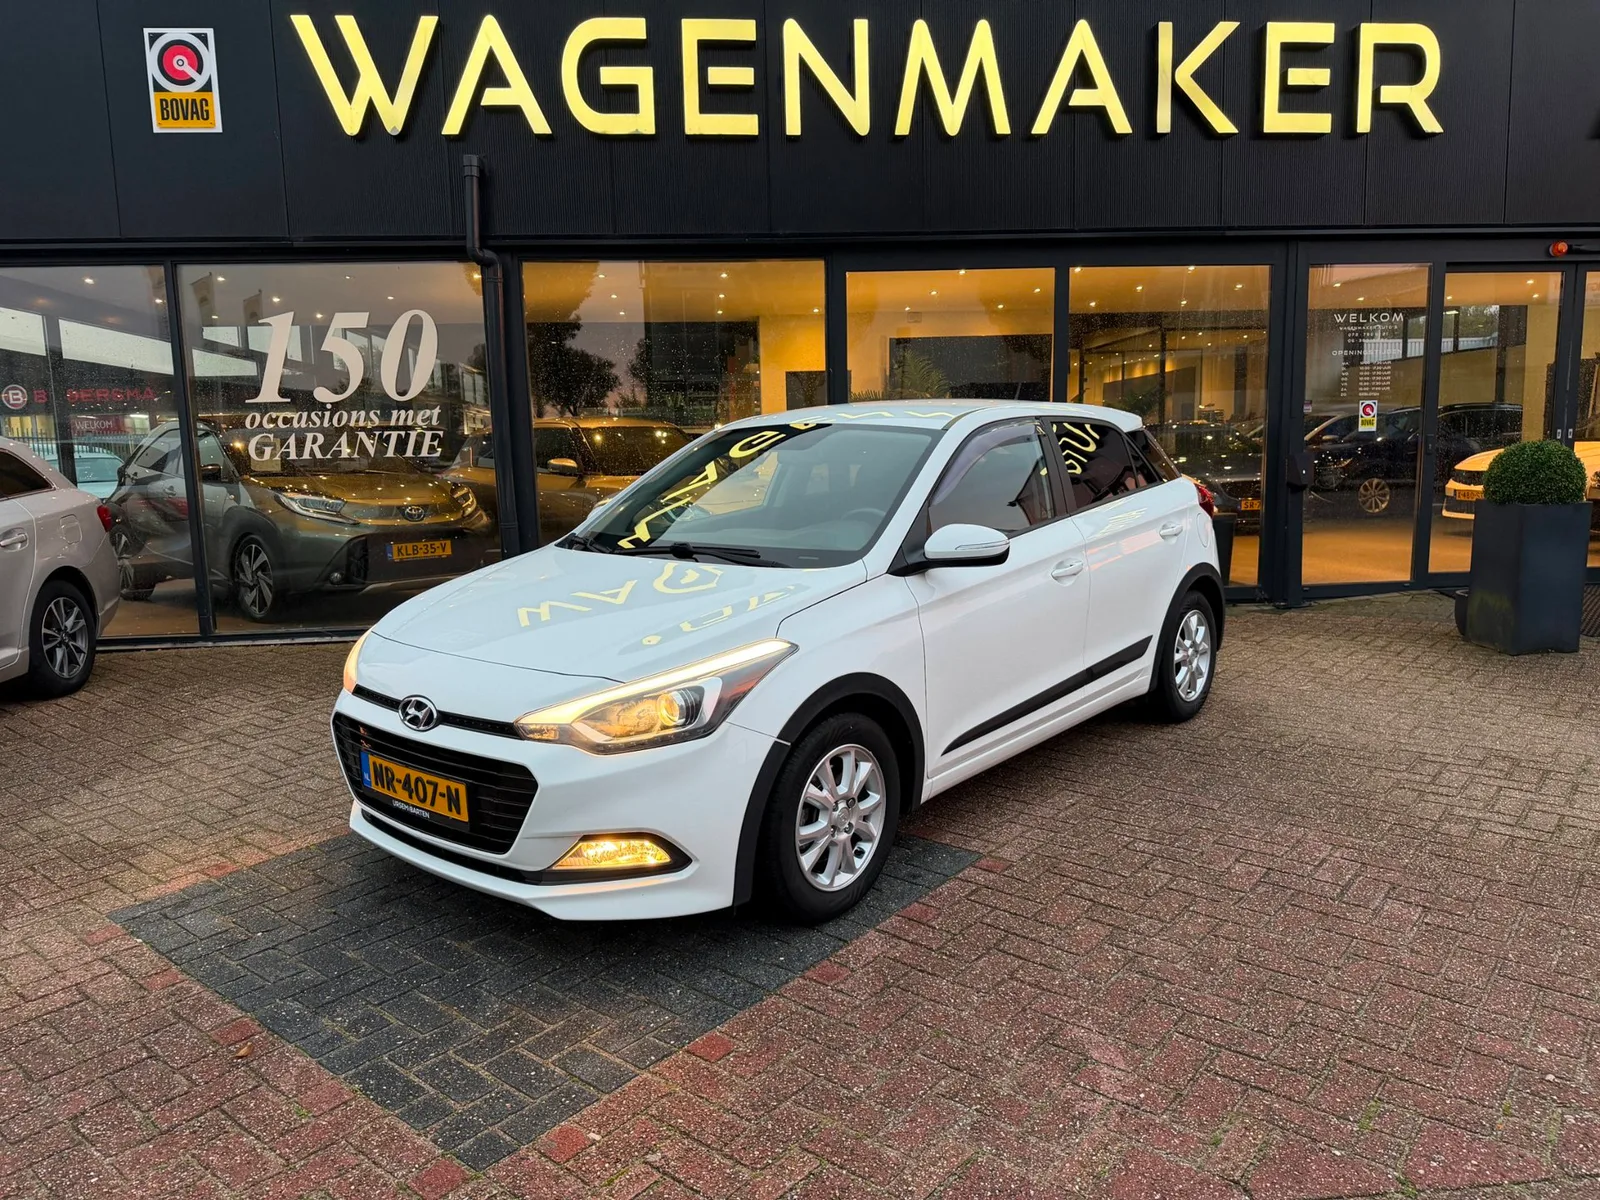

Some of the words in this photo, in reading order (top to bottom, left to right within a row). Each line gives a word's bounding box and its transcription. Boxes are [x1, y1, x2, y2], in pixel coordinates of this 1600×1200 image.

[290, 14, 1444, 136] WAGENMAKER
[159, 97, 210, 121] BOVAG
[1334, 312, 1404, 323] WELKOM
[245, 309, 439, 404] 150
[75, 420, 113, 429] WELKOM
[245, 403, 380, 430] occasions
[391, 405, 441, 427] met
[248, 430, 444, 461] GARANTIE
[397, 542, 447, 557] KLB-35-V
[372, 760, 461, 816] NR-407-N
